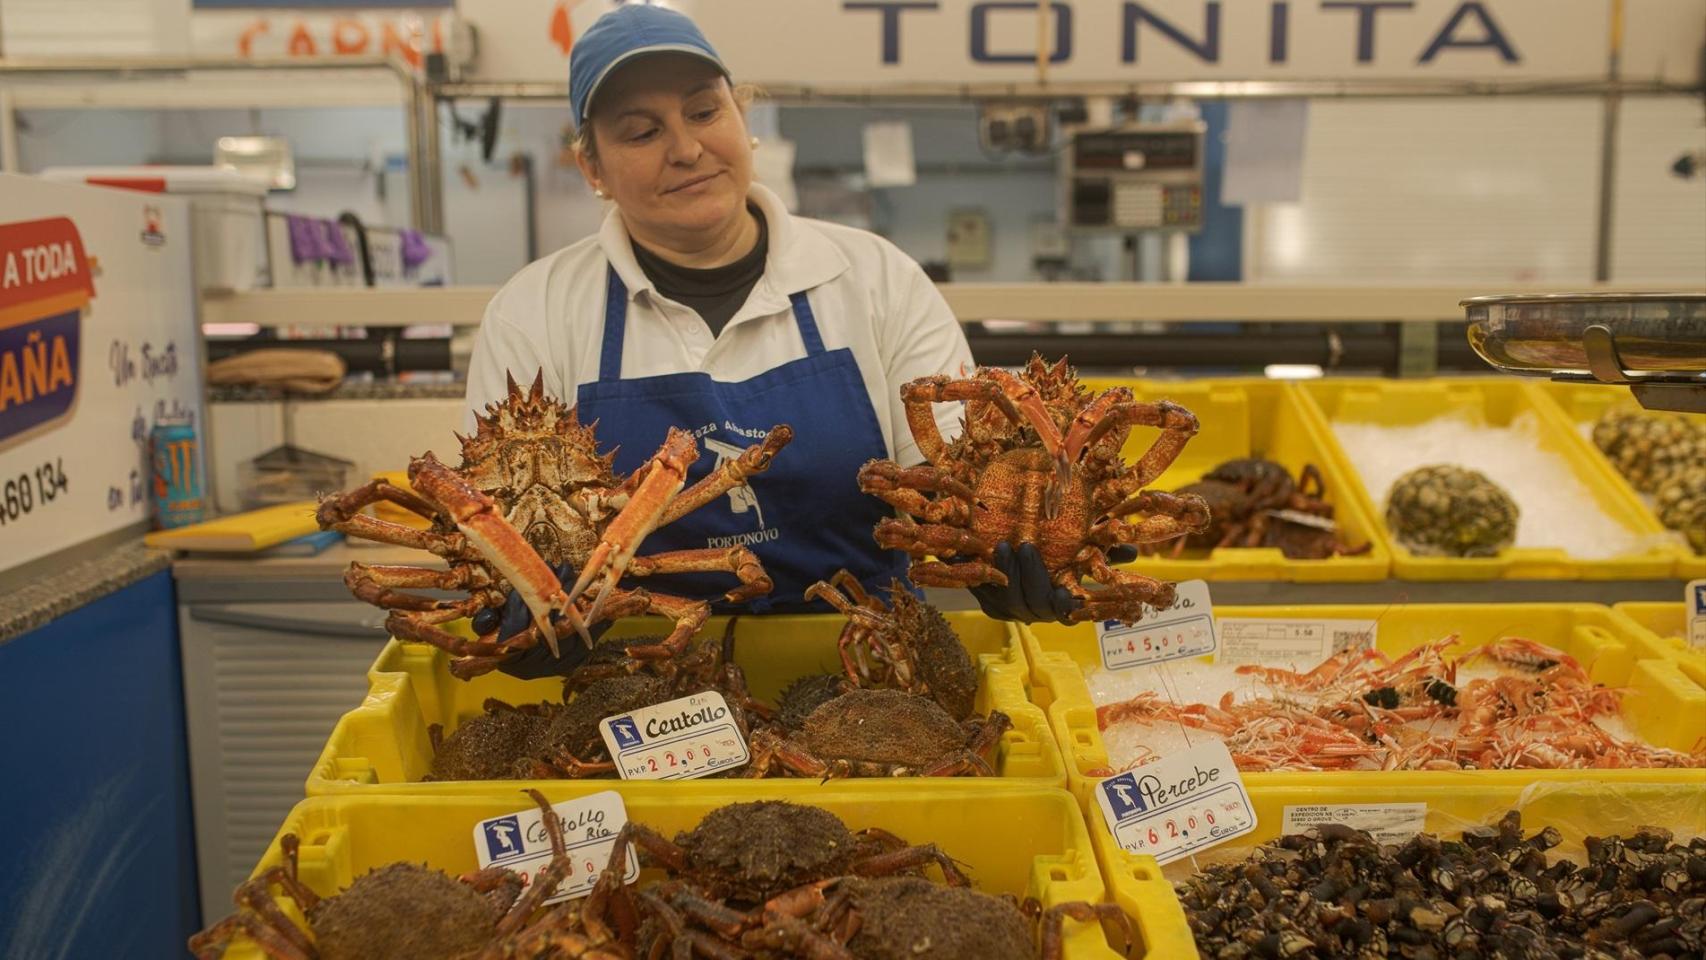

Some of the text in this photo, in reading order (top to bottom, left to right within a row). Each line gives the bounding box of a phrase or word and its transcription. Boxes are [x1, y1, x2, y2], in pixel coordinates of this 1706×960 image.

[842, 1, 1522, 65] TONITA
[3, 241, 77, 289] A TODA
[694, 422, 718, 438] aza
[36, 456, 68, 506] 134
[707, 528, 780, 548] PORTONOVO
[1143, 593, 1196, 619] igla
[645, 706, 726, 738] Centollo
[1138, 766, 1220, 808] Percebe
